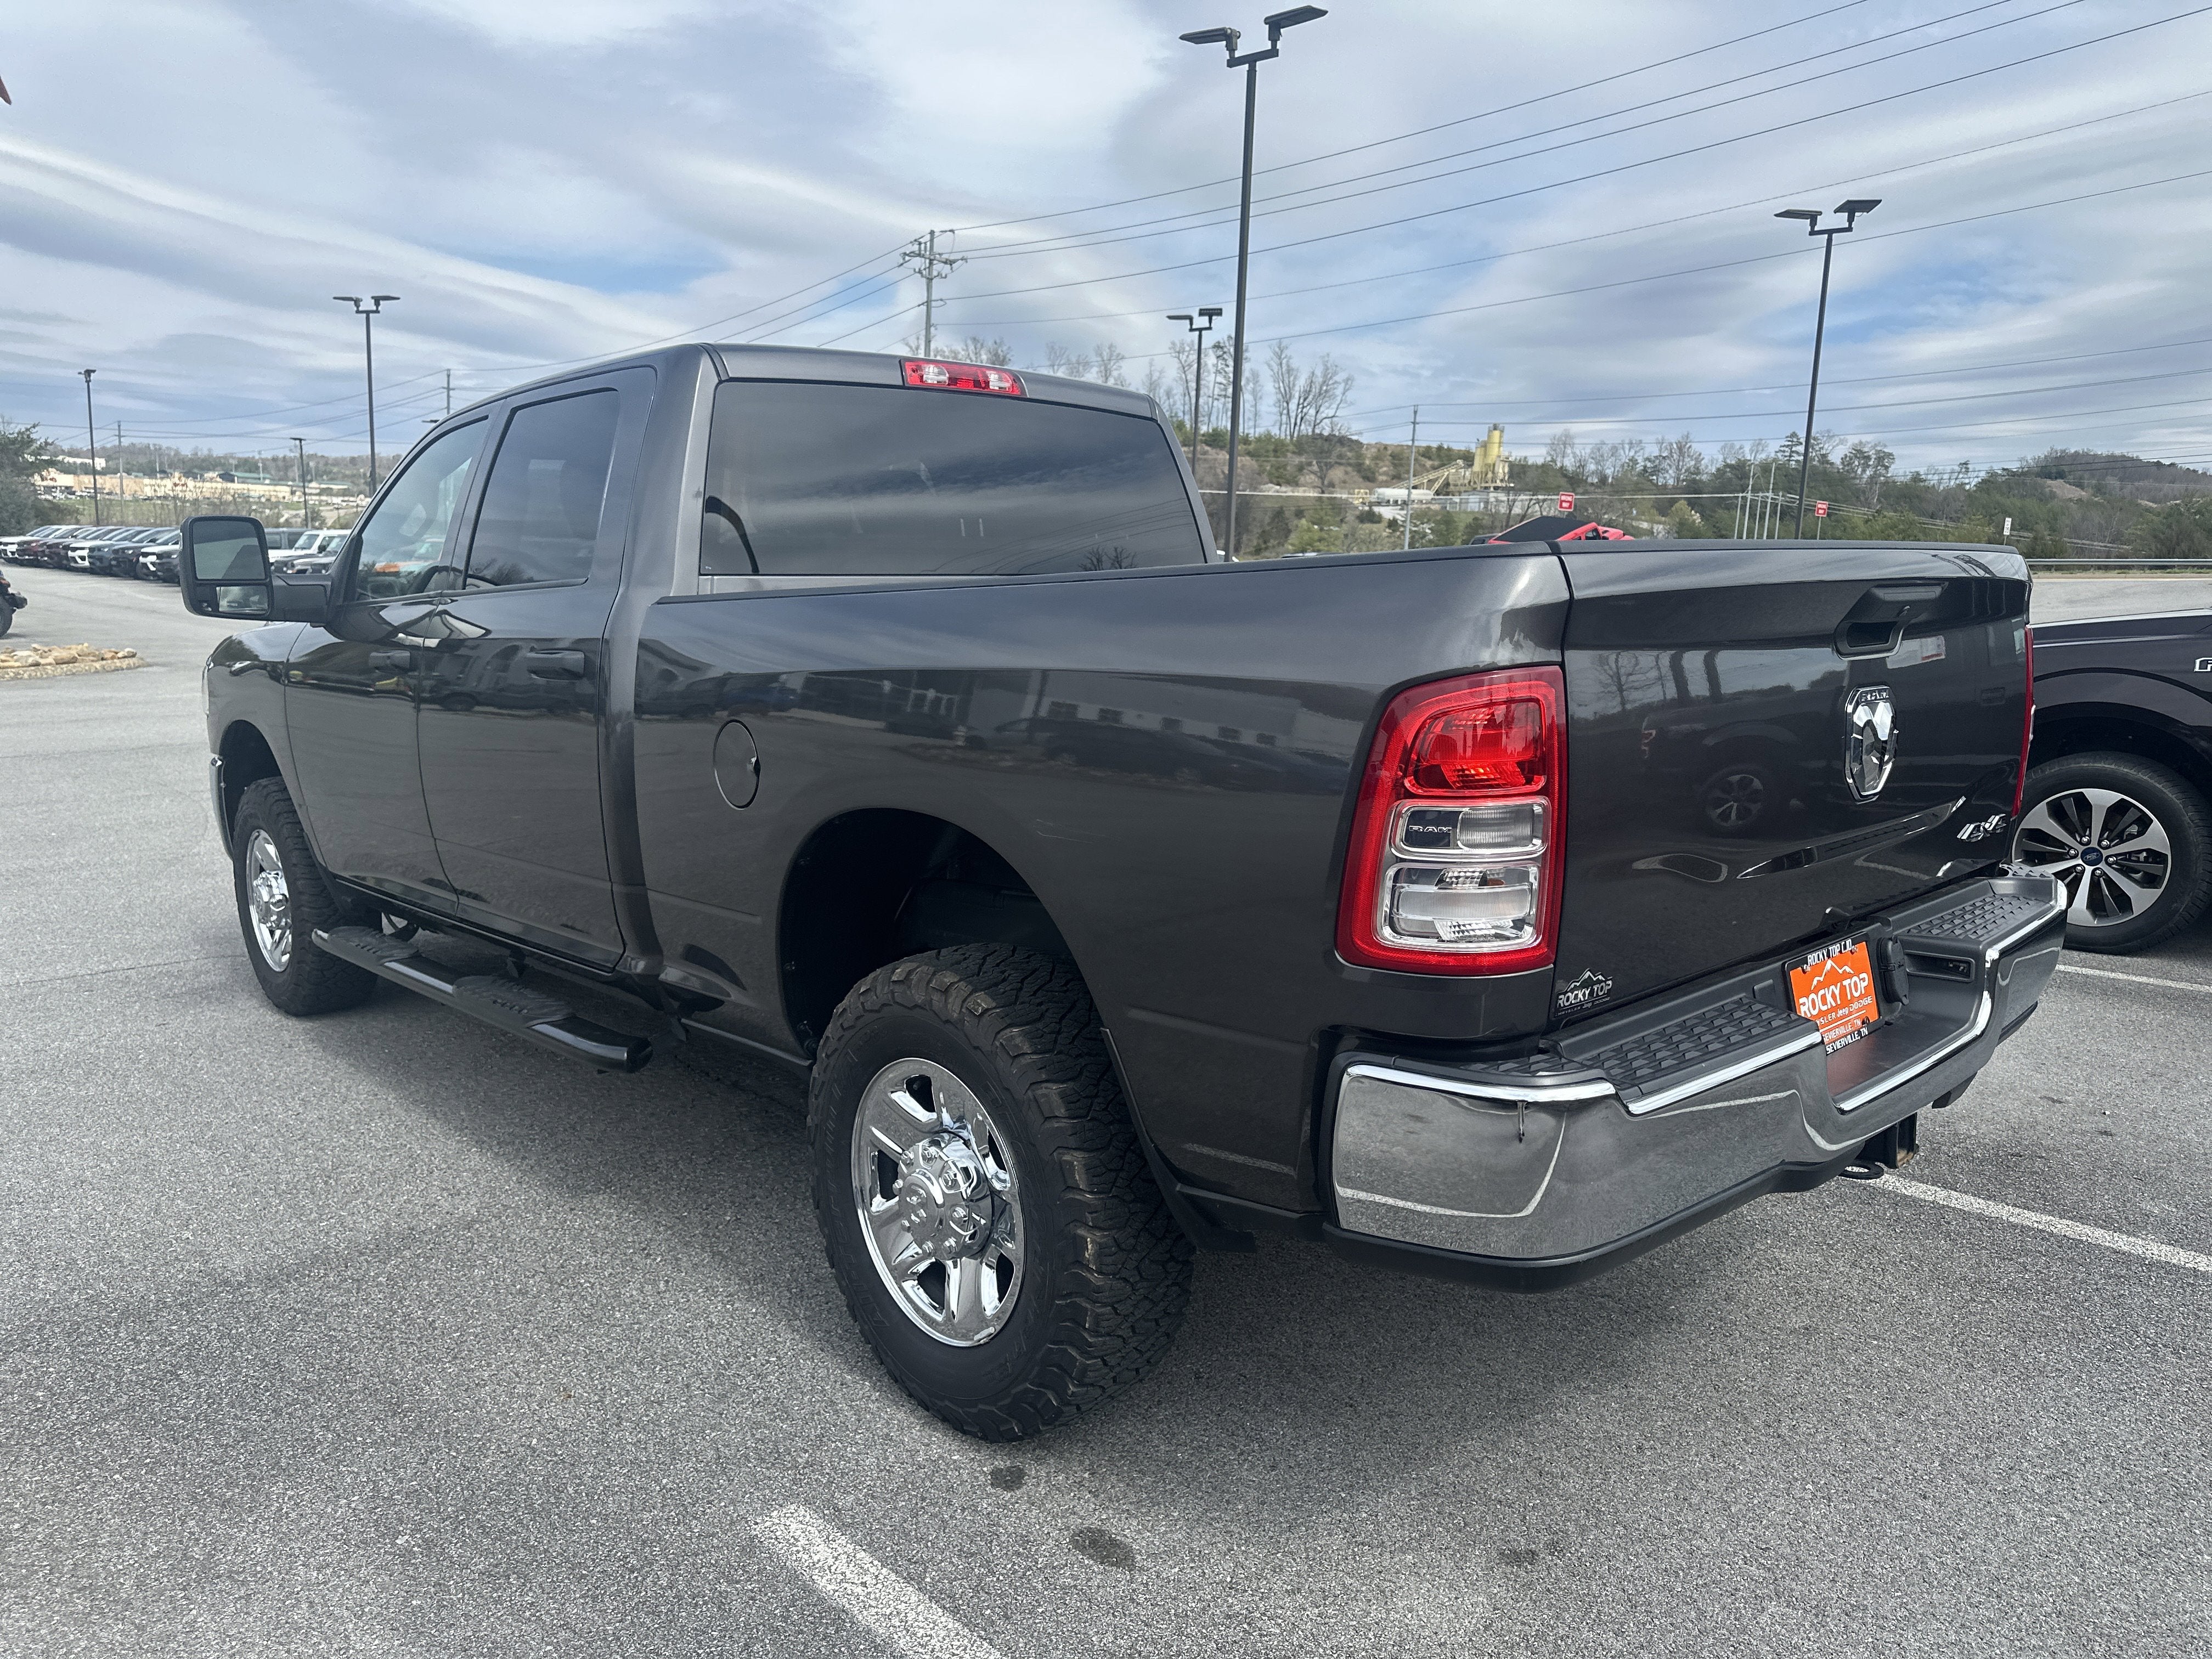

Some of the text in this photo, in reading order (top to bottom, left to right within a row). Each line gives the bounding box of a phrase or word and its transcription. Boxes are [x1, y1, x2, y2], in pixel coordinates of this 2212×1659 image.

[1408, 825, 1452, 833] RAM
[1807, 948, 1827, 966] ROCKY
[1829, 943, 1841, 958] TOP
[1557, 986, 1592, 1008] ROCKY
[1593, 980, 1613, 997] TOP
[1799, 972, 1869, 1018] ROCKY TOP
[1836, 1007, 1849, 1018] Jeep
[1849, 995, 1873, 1012] DODGE
[1853, 1018, 1861, 1028] TN
[1860, 1026, 1868, 1037] TN
